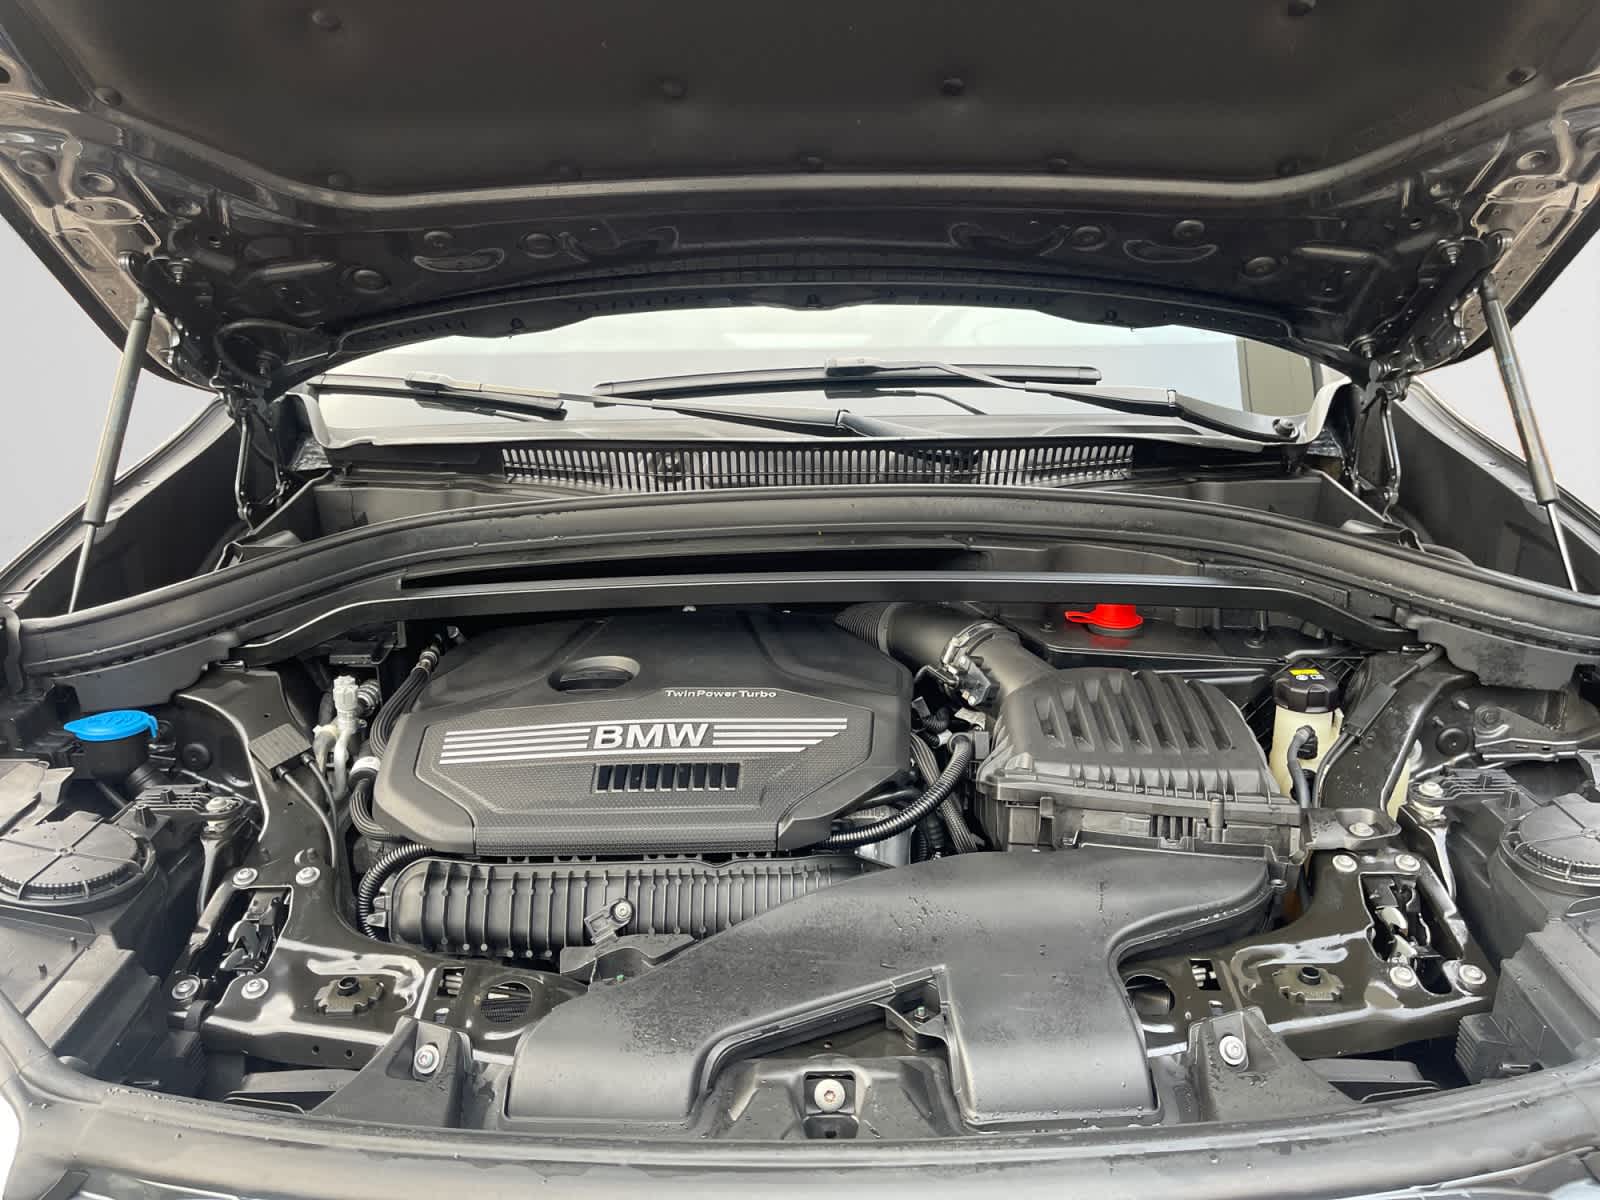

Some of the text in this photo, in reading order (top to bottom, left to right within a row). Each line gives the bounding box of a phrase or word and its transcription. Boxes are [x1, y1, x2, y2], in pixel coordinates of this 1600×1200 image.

[664, 689, 777, 698] TwinPower Turbo
[593, 723, 709, 749] BMW
